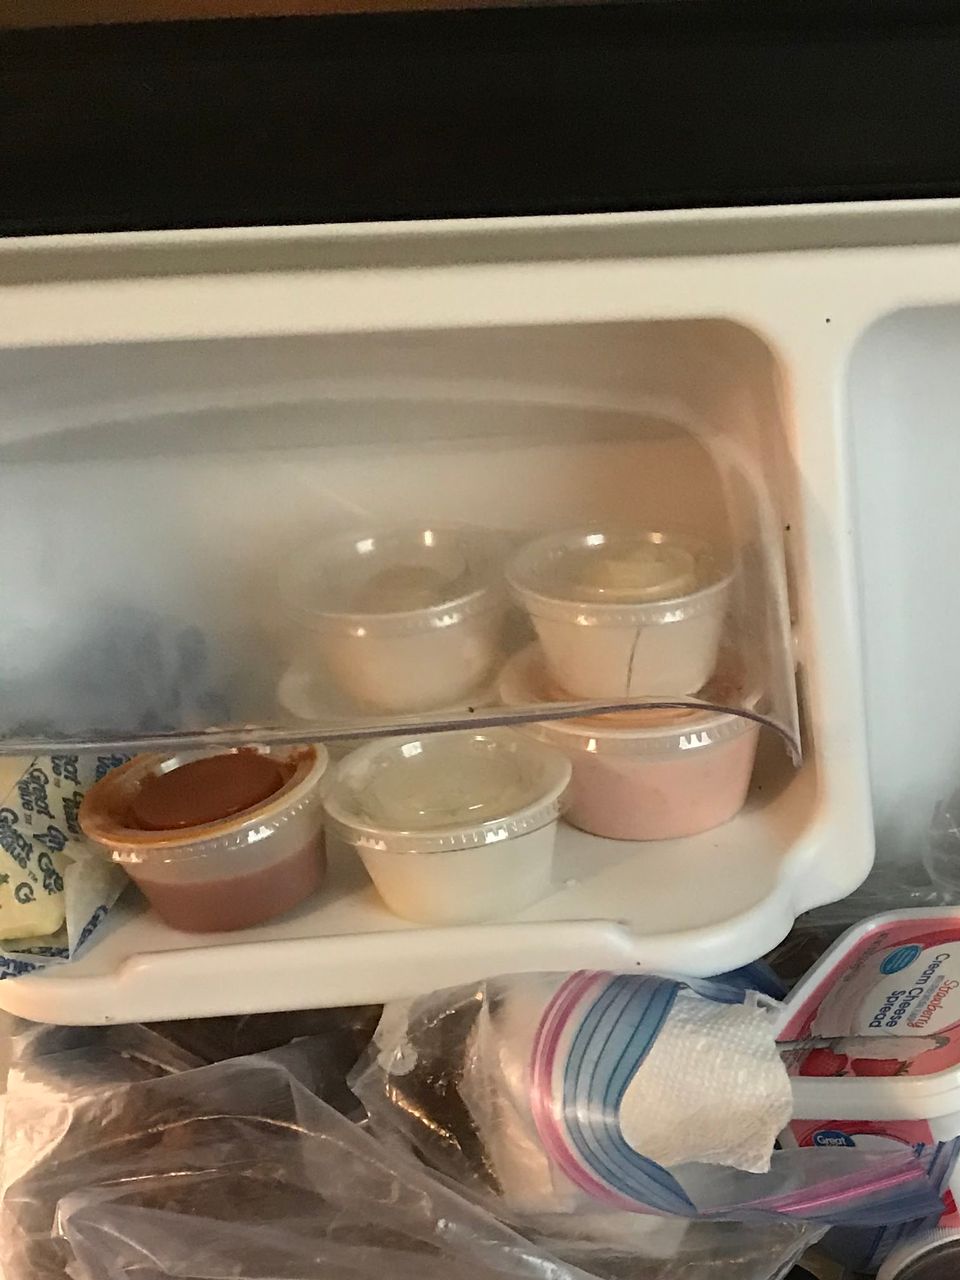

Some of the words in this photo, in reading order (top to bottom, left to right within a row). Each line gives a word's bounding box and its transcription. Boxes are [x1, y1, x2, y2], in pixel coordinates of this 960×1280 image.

[916, 953, 950, 984] Cream
[869, 990, 906, 1028] Spread
[886, 987, 923, 1027] Cheese
[907, 980, 960, 1028] Strawberry
[817, 1136, 846, 1145] Great
